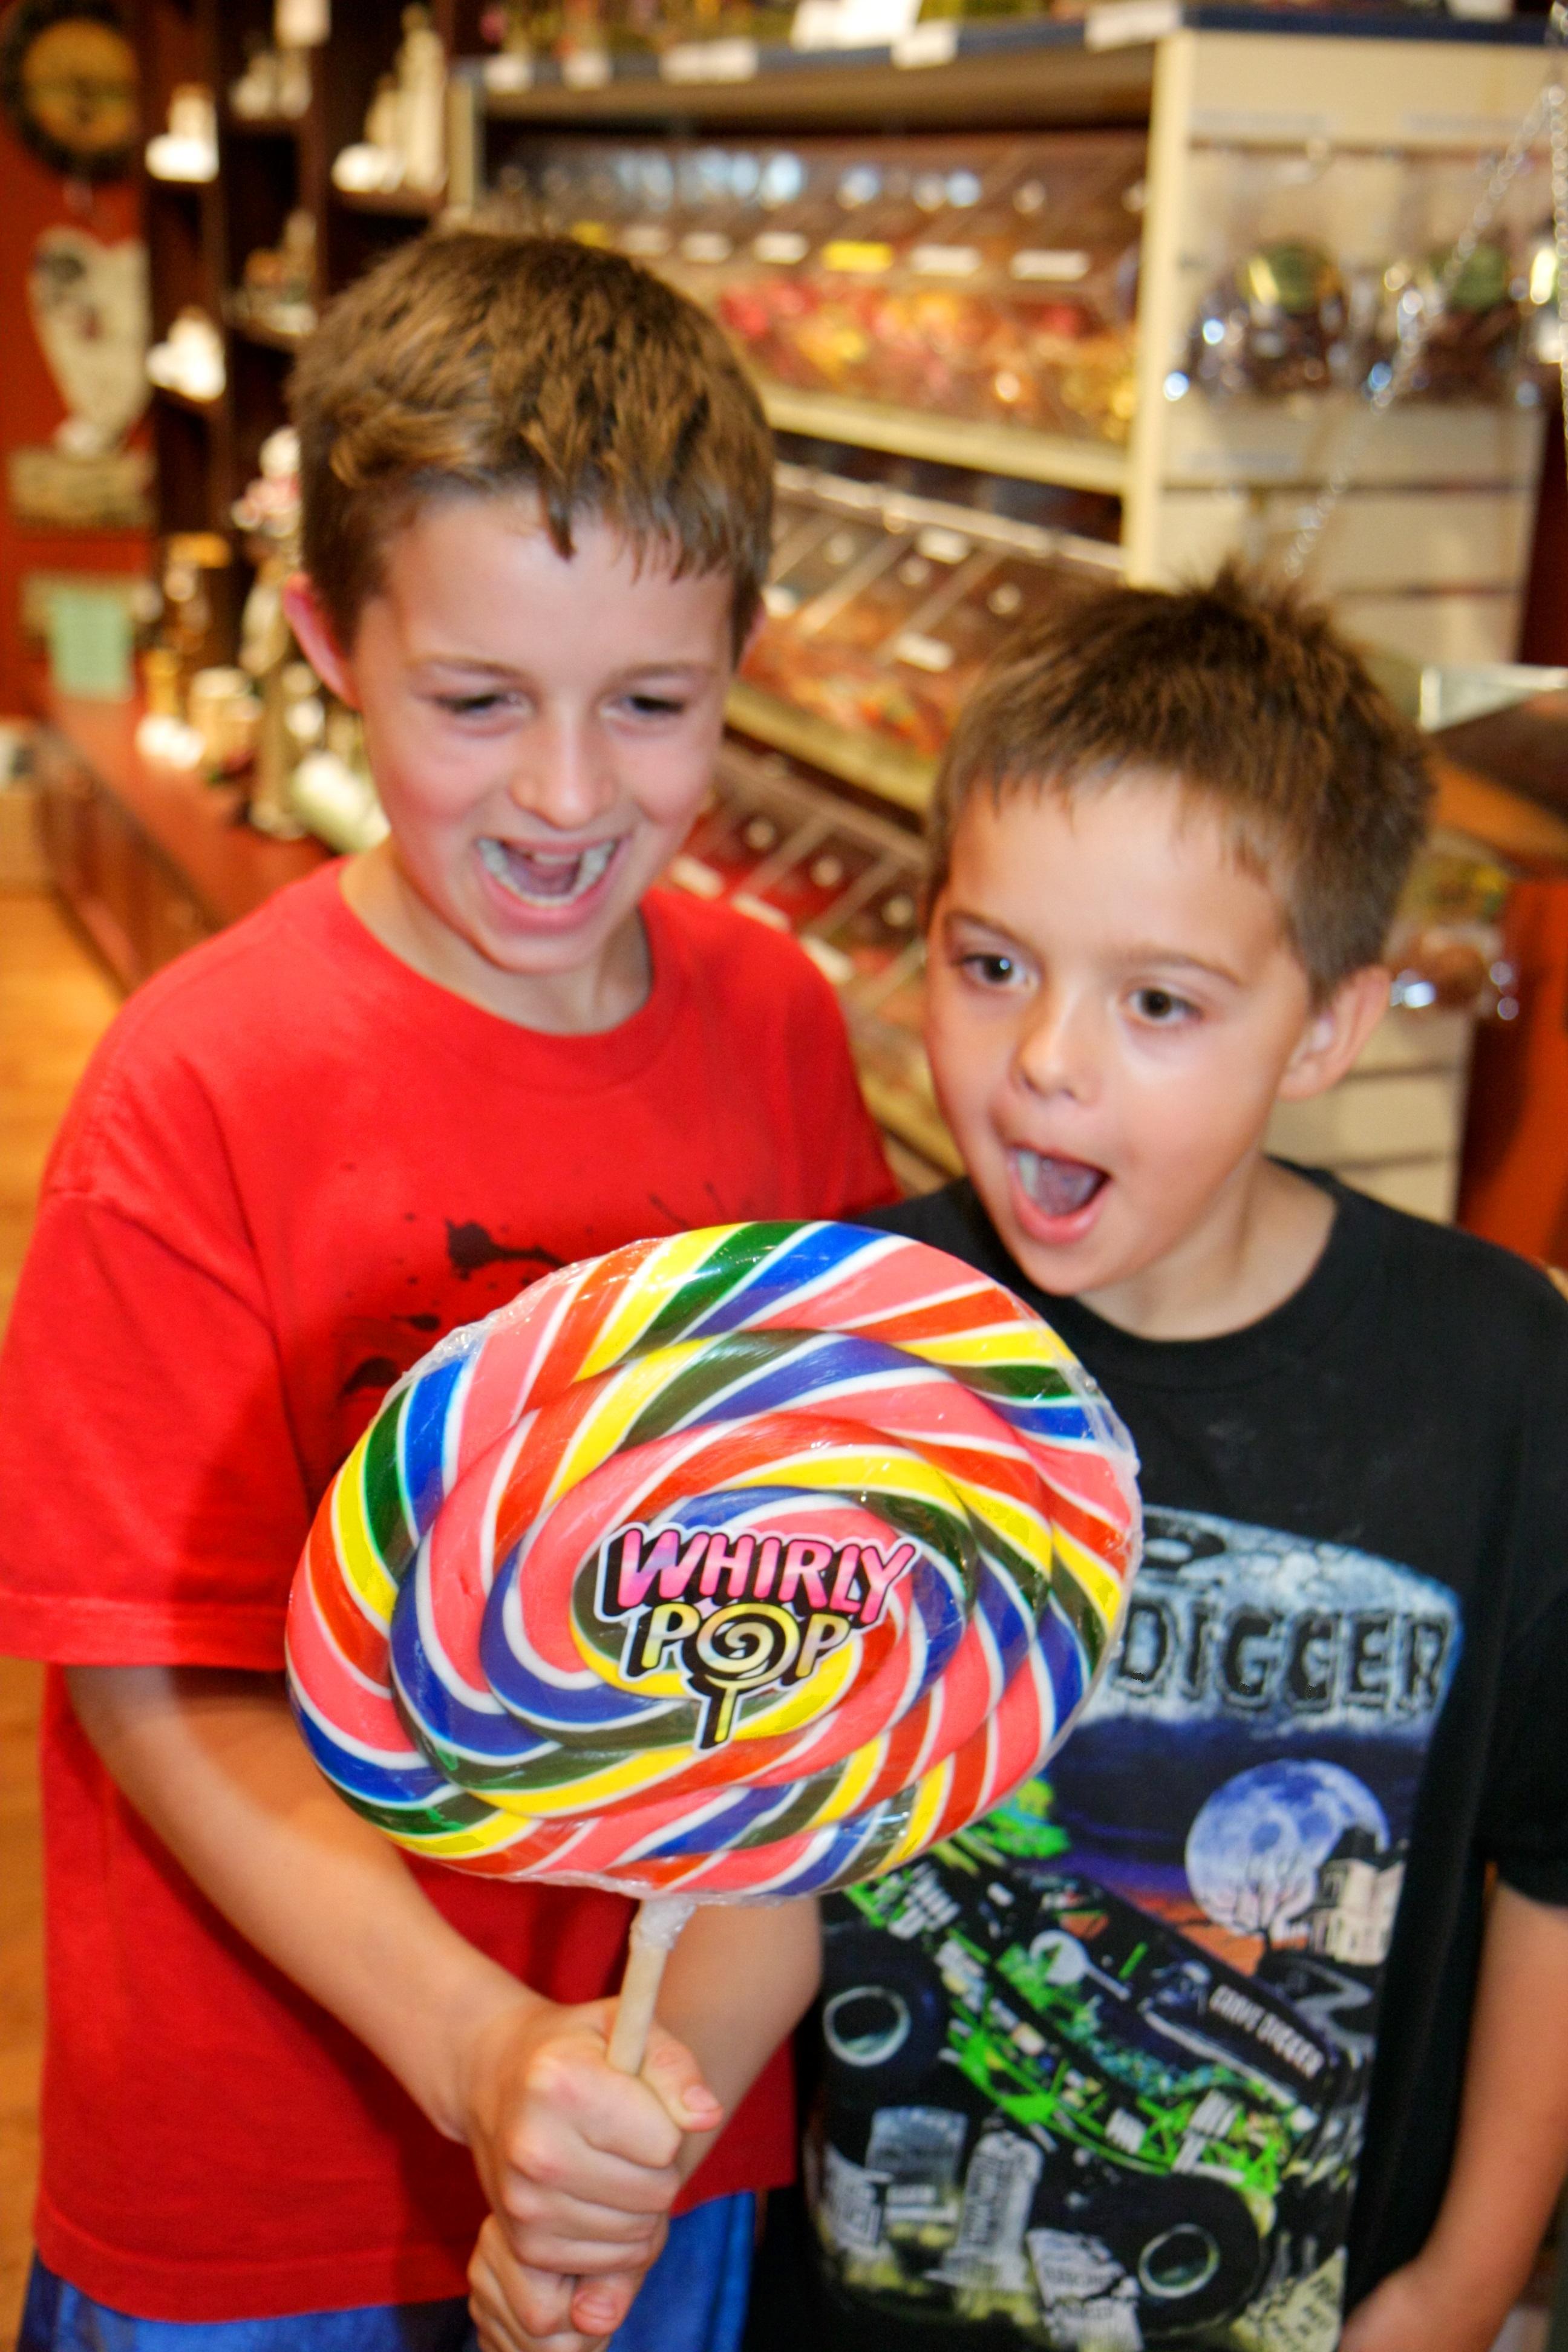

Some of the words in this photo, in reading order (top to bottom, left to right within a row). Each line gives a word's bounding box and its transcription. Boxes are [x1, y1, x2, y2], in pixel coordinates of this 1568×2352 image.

[601, 1526, 916, 1629] WHIRLY
[626, 1601, 851, 1747] POP
[1116, 1600, 1449, 1710] DIGGER
